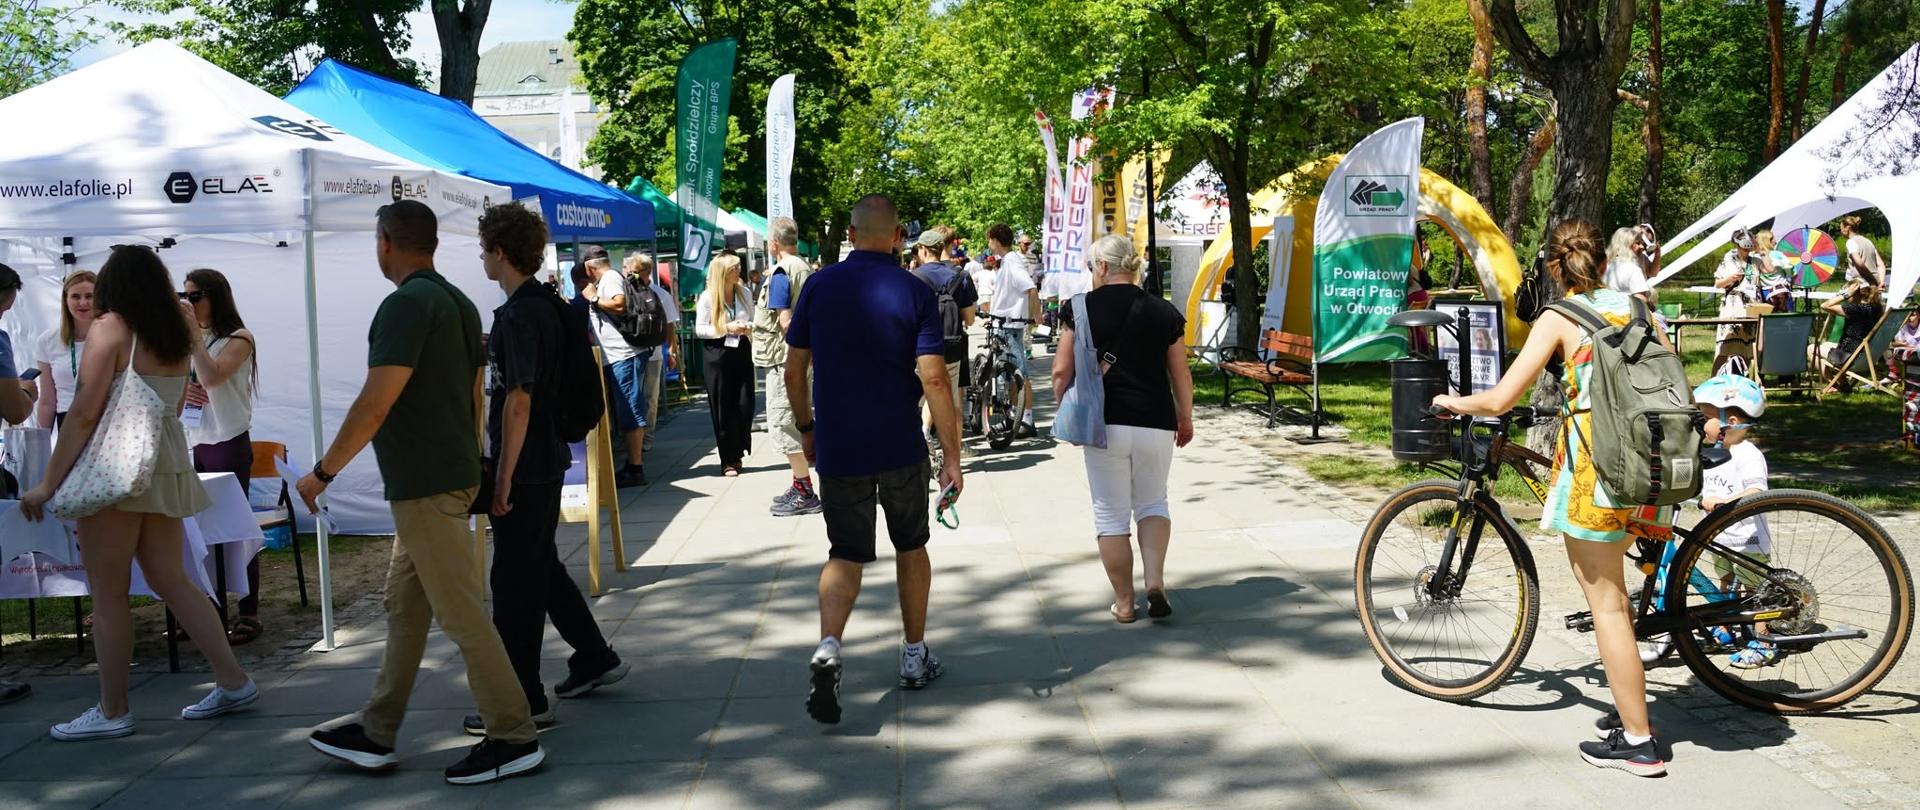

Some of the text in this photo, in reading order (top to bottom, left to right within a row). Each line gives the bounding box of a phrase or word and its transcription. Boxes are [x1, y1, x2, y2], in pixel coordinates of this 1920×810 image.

[708, 81, 720, 134] Grupa BPS
[686, 79, 705, 173] Spółdzielczy
[0, 179, 132, 199] www.elafolie.pl
[324, 178, 381, 198] www.elafolie.pl
[556, 201, 606, 228] castorama
[1333, 268, 1408, 283] Powiatowy
[1324, 284, 1406, 300] Urząd Pracy
[1331, 303, 1402, 316] w Otwock
